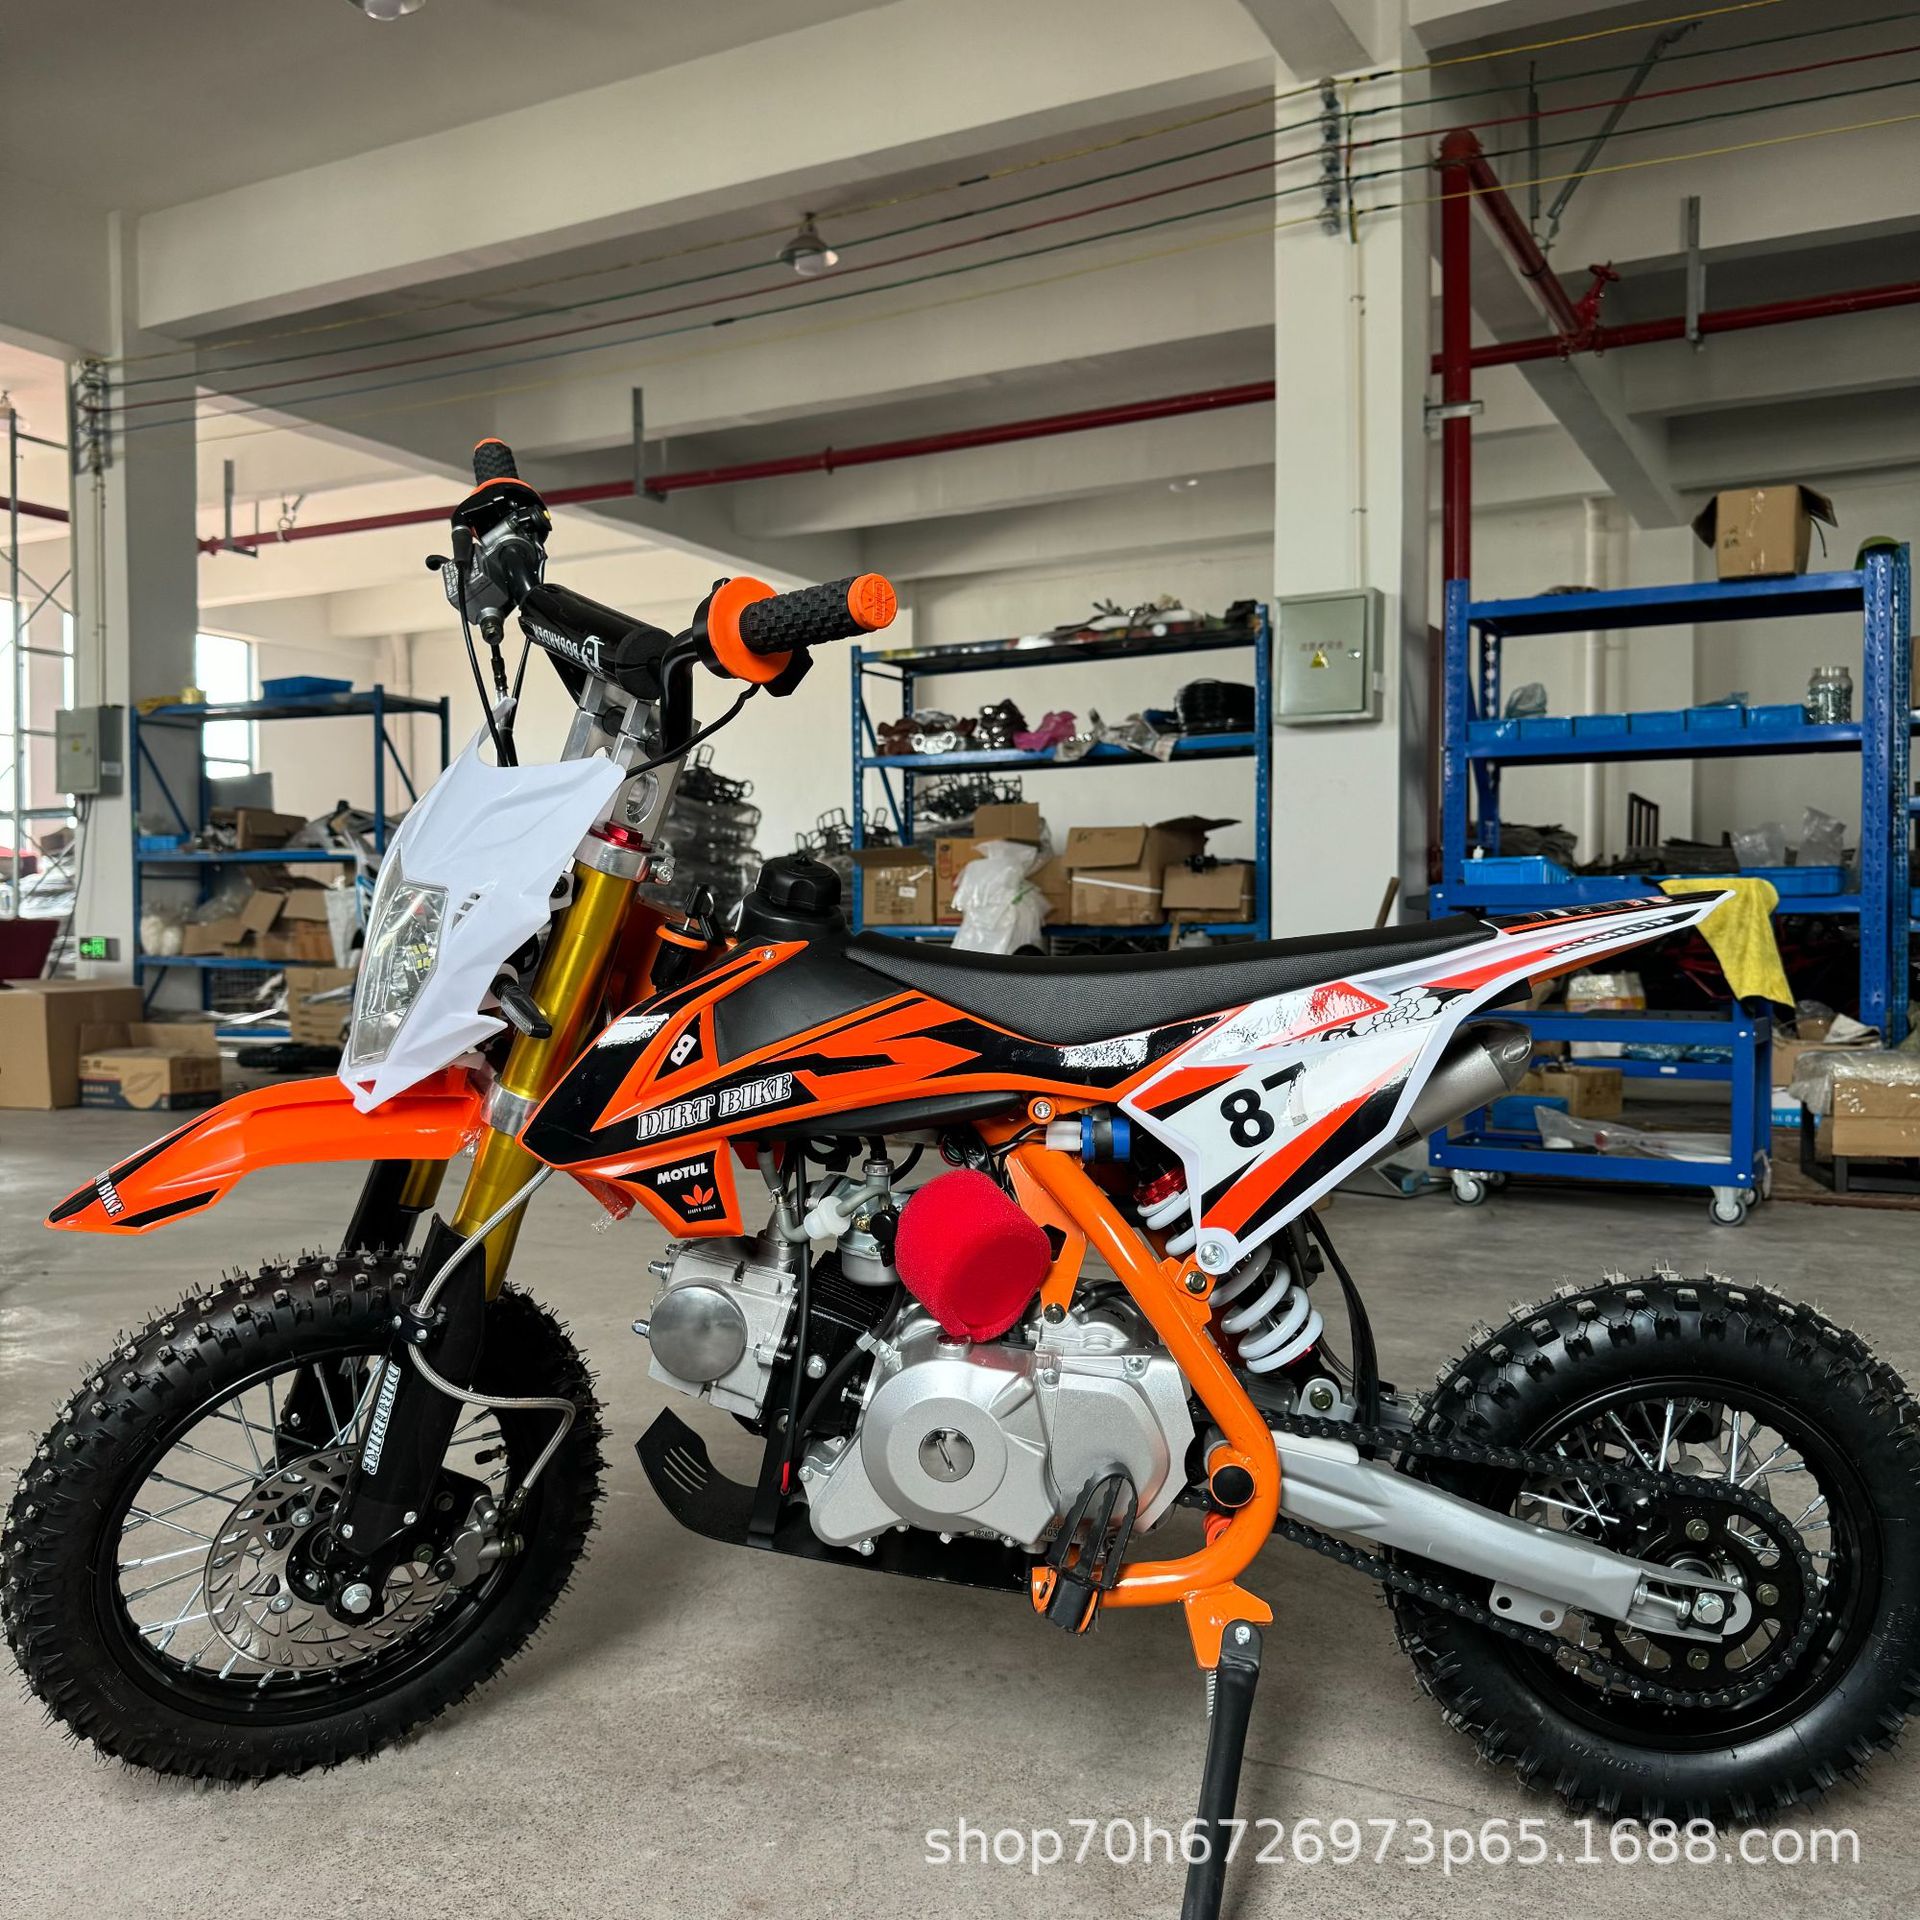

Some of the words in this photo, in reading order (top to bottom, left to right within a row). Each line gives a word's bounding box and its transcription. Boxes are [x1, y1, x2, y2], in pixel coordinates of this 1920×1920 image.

[1551, 917, 1674, 953] MICHELIN
[636, 1094, 715, 1140] DIRT
[718, 1072, 792, 1117] BIKE
[657, 1162, 709, 1185] MOTUL
[97, 1181, 125, 1217] BIKE
